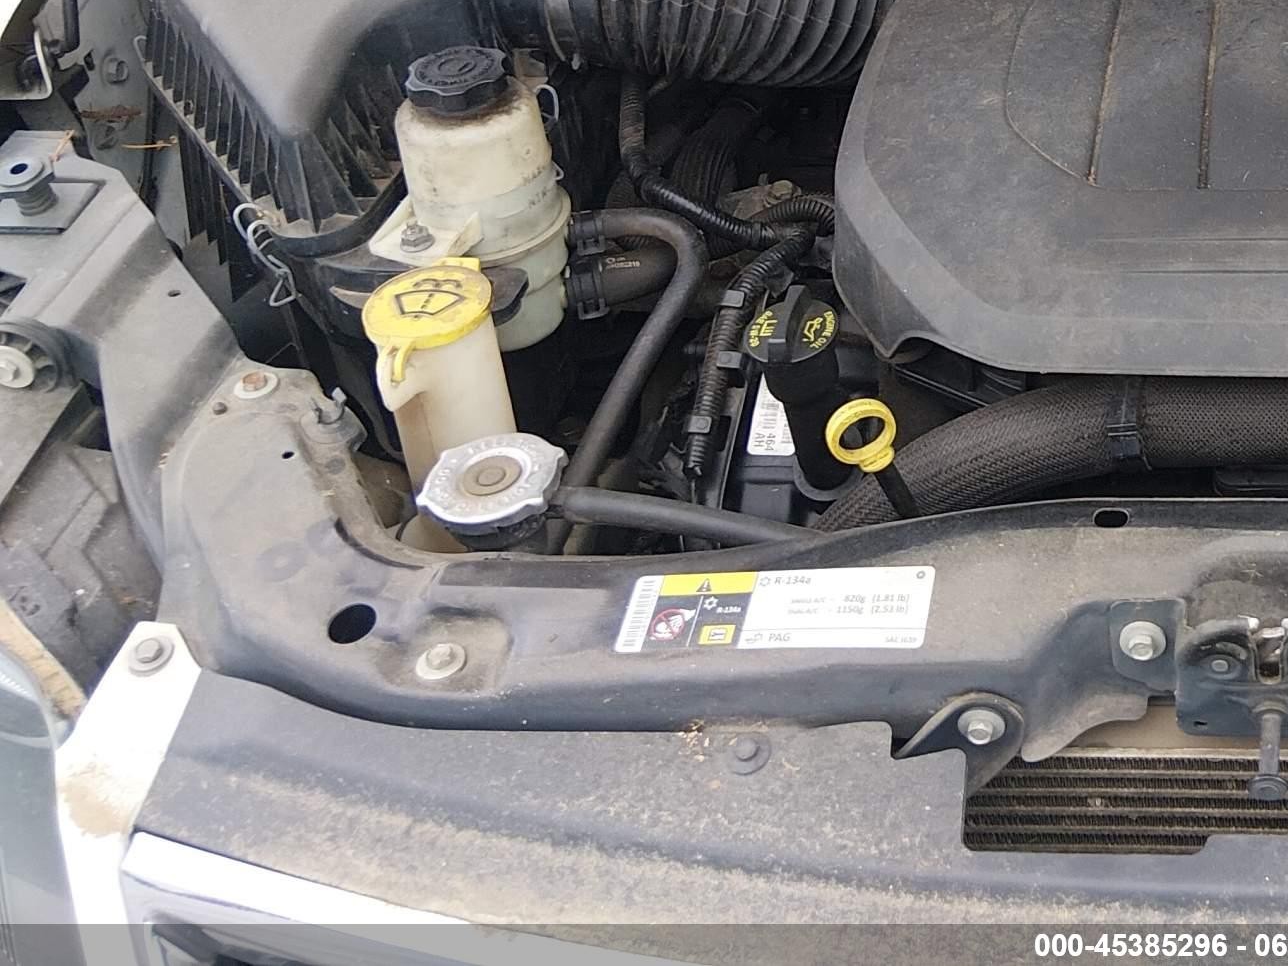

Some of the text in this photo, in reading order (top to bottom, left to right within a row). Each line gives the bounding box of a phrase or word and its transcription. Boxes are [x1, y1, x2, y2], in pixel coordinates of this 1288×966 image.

[809, 310, 836, 349] ENGINE OIL
[774, 576, 812, 586] R-134a
[768, 632, 792, 642] PAG
